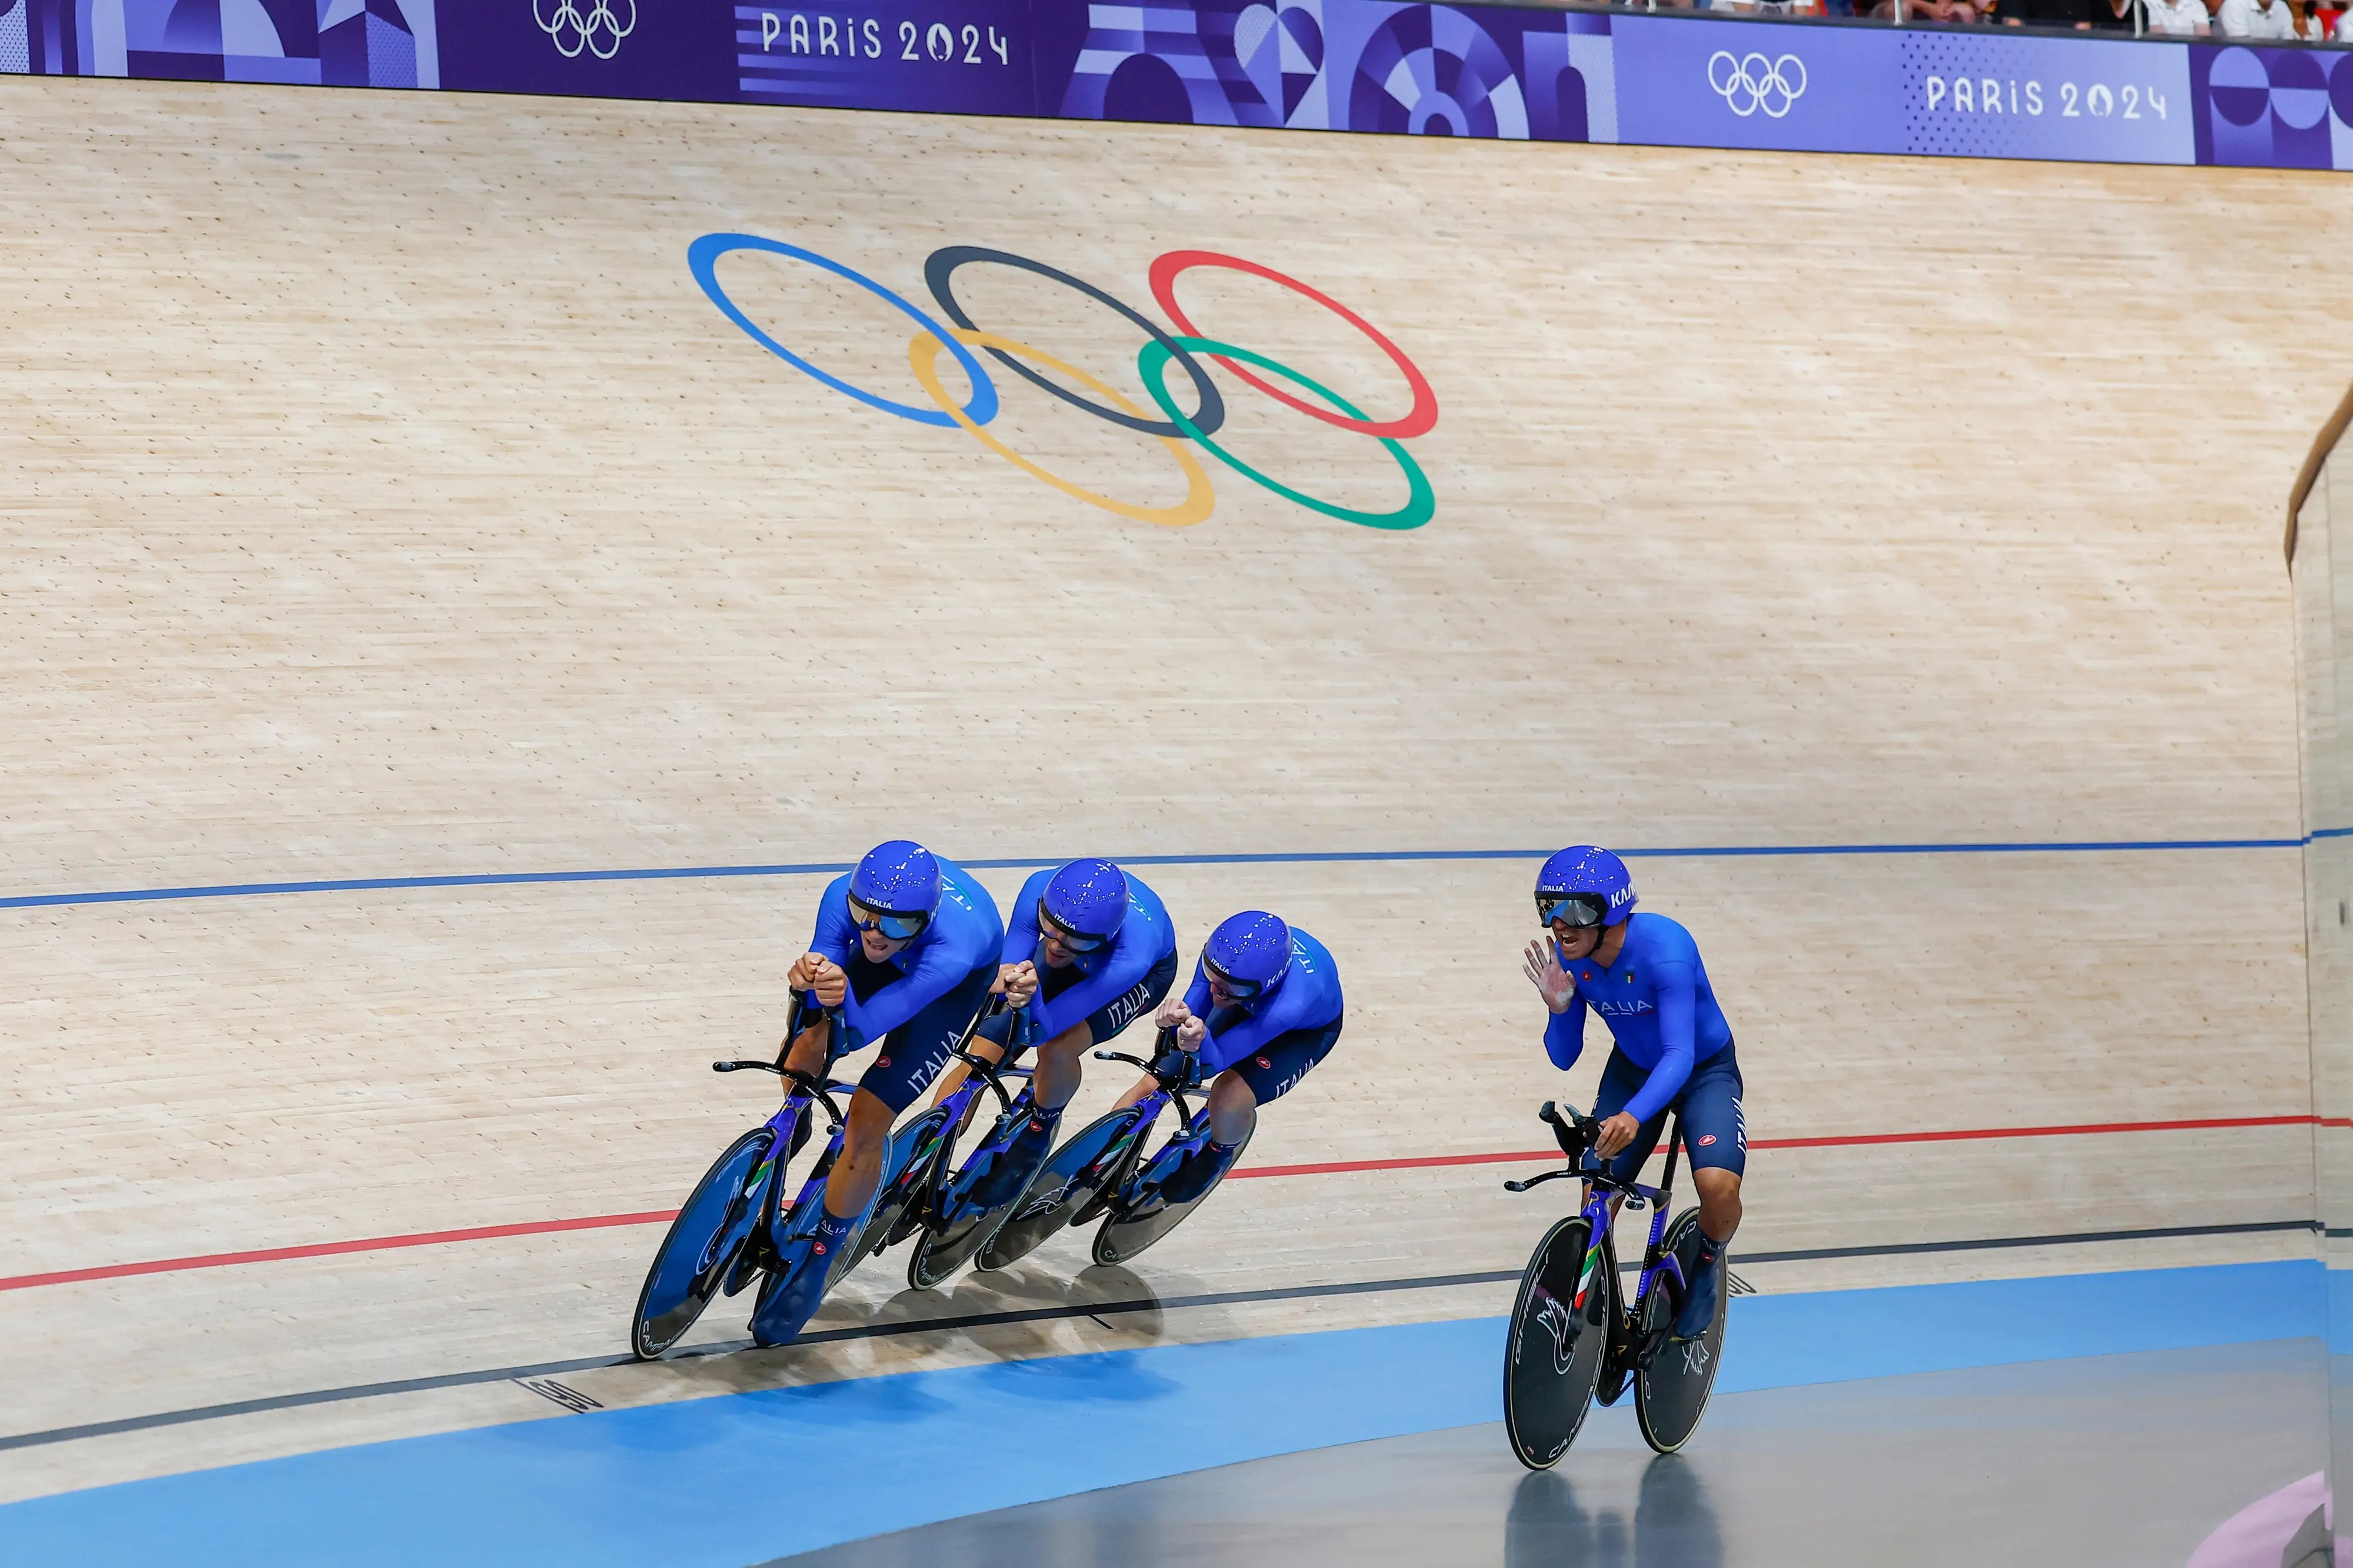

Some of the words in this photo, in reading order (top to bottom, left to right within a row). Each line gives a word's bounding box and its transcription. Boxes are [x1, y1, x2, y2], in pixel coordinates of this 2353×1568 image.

[898, 21, 1009, 66] 2024
[2060, 81, 2168, 120] 2024
[866, 896, 892, 910] ITALIA
[1054, 913, 1076, 930] ITALIA
[1210, 957, 1230, 975] ITALIA
[1107, 983, 1151, 1029] ITALIA
[1585, 999, 1654, 1012] TALIA
[906, 1030, 962, 1095] ITALIA
